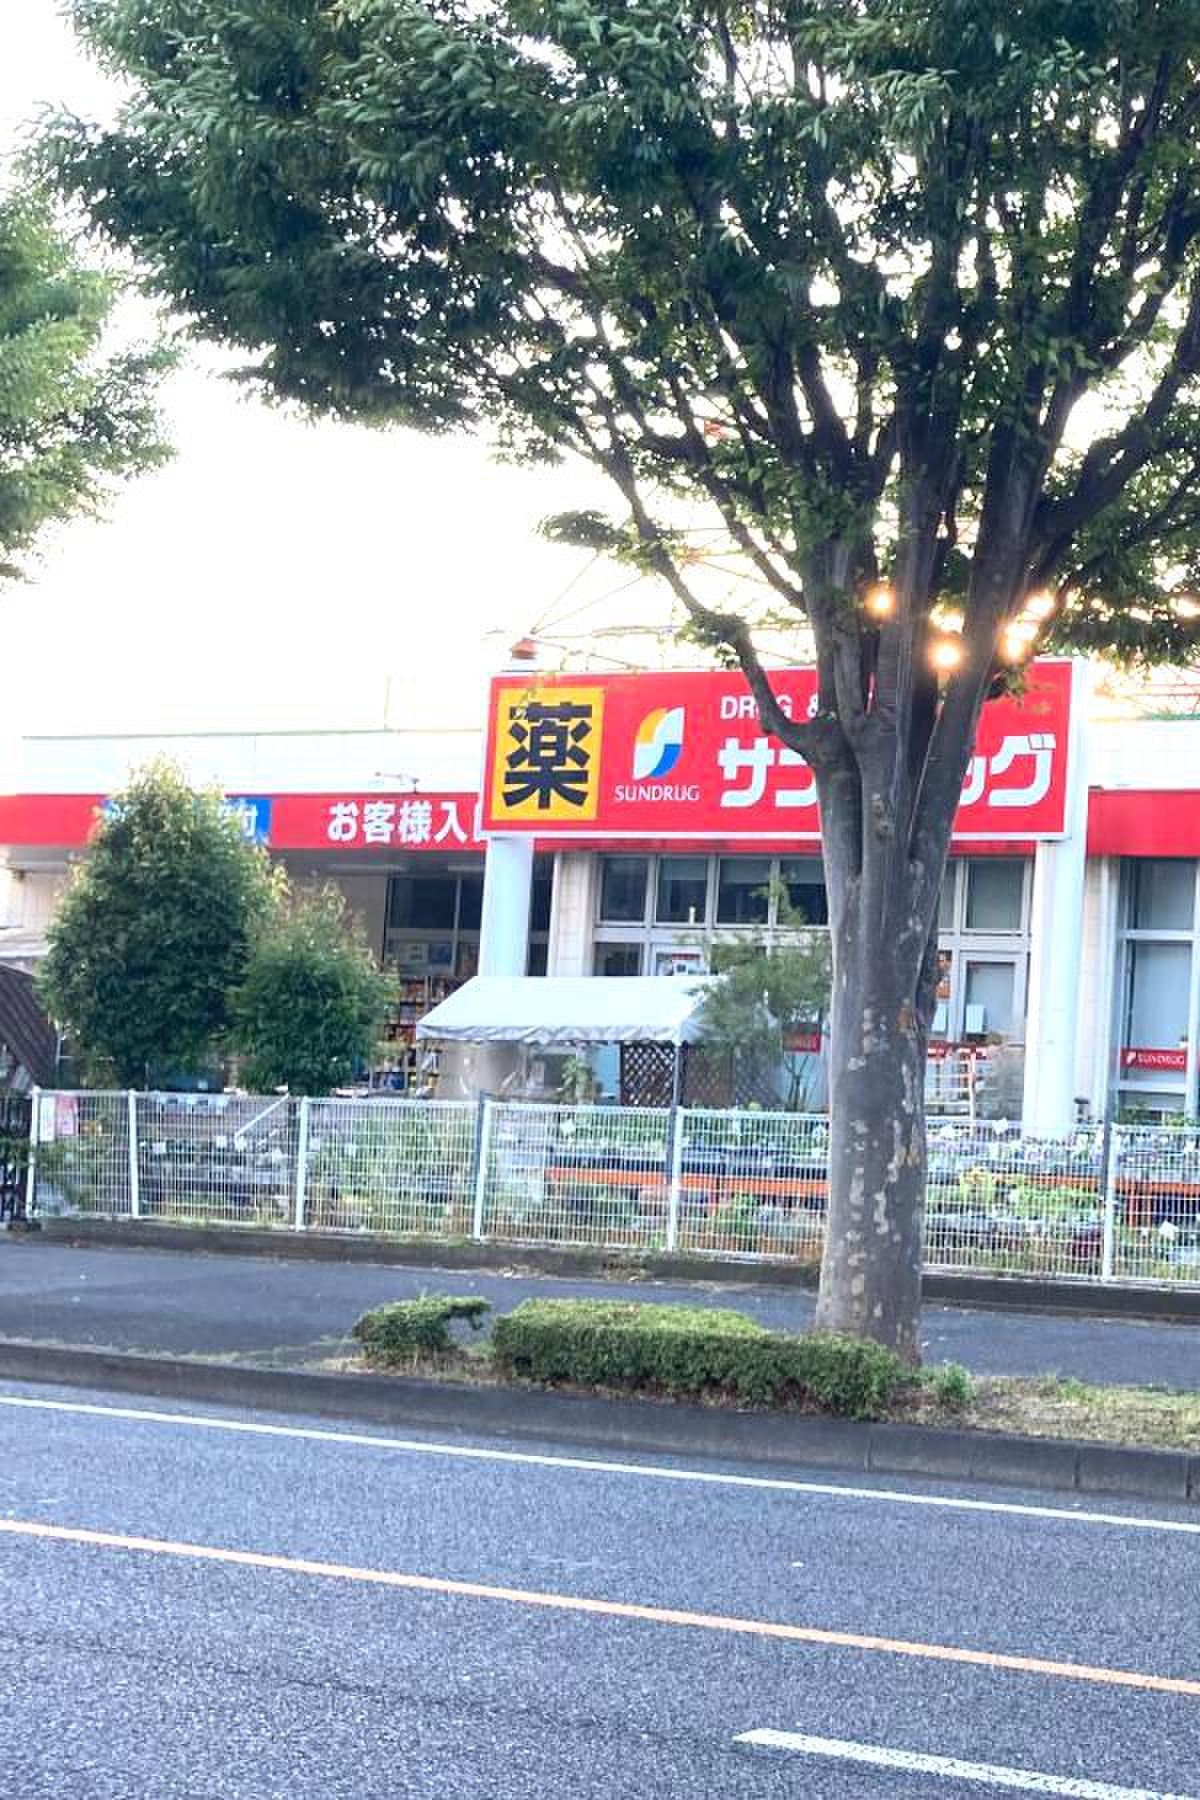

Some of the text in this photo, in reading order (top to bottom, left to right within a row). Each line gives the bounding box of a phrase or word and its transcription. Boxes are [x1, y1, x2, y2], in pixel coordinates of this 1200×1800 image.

[720, 693, 793, 720] DRG
[502, 701, 592, 809] 薬
[614, 784, 700, 802] SUNDRUG
[1137, 1053, 1185, 1066] SUNDRUG
